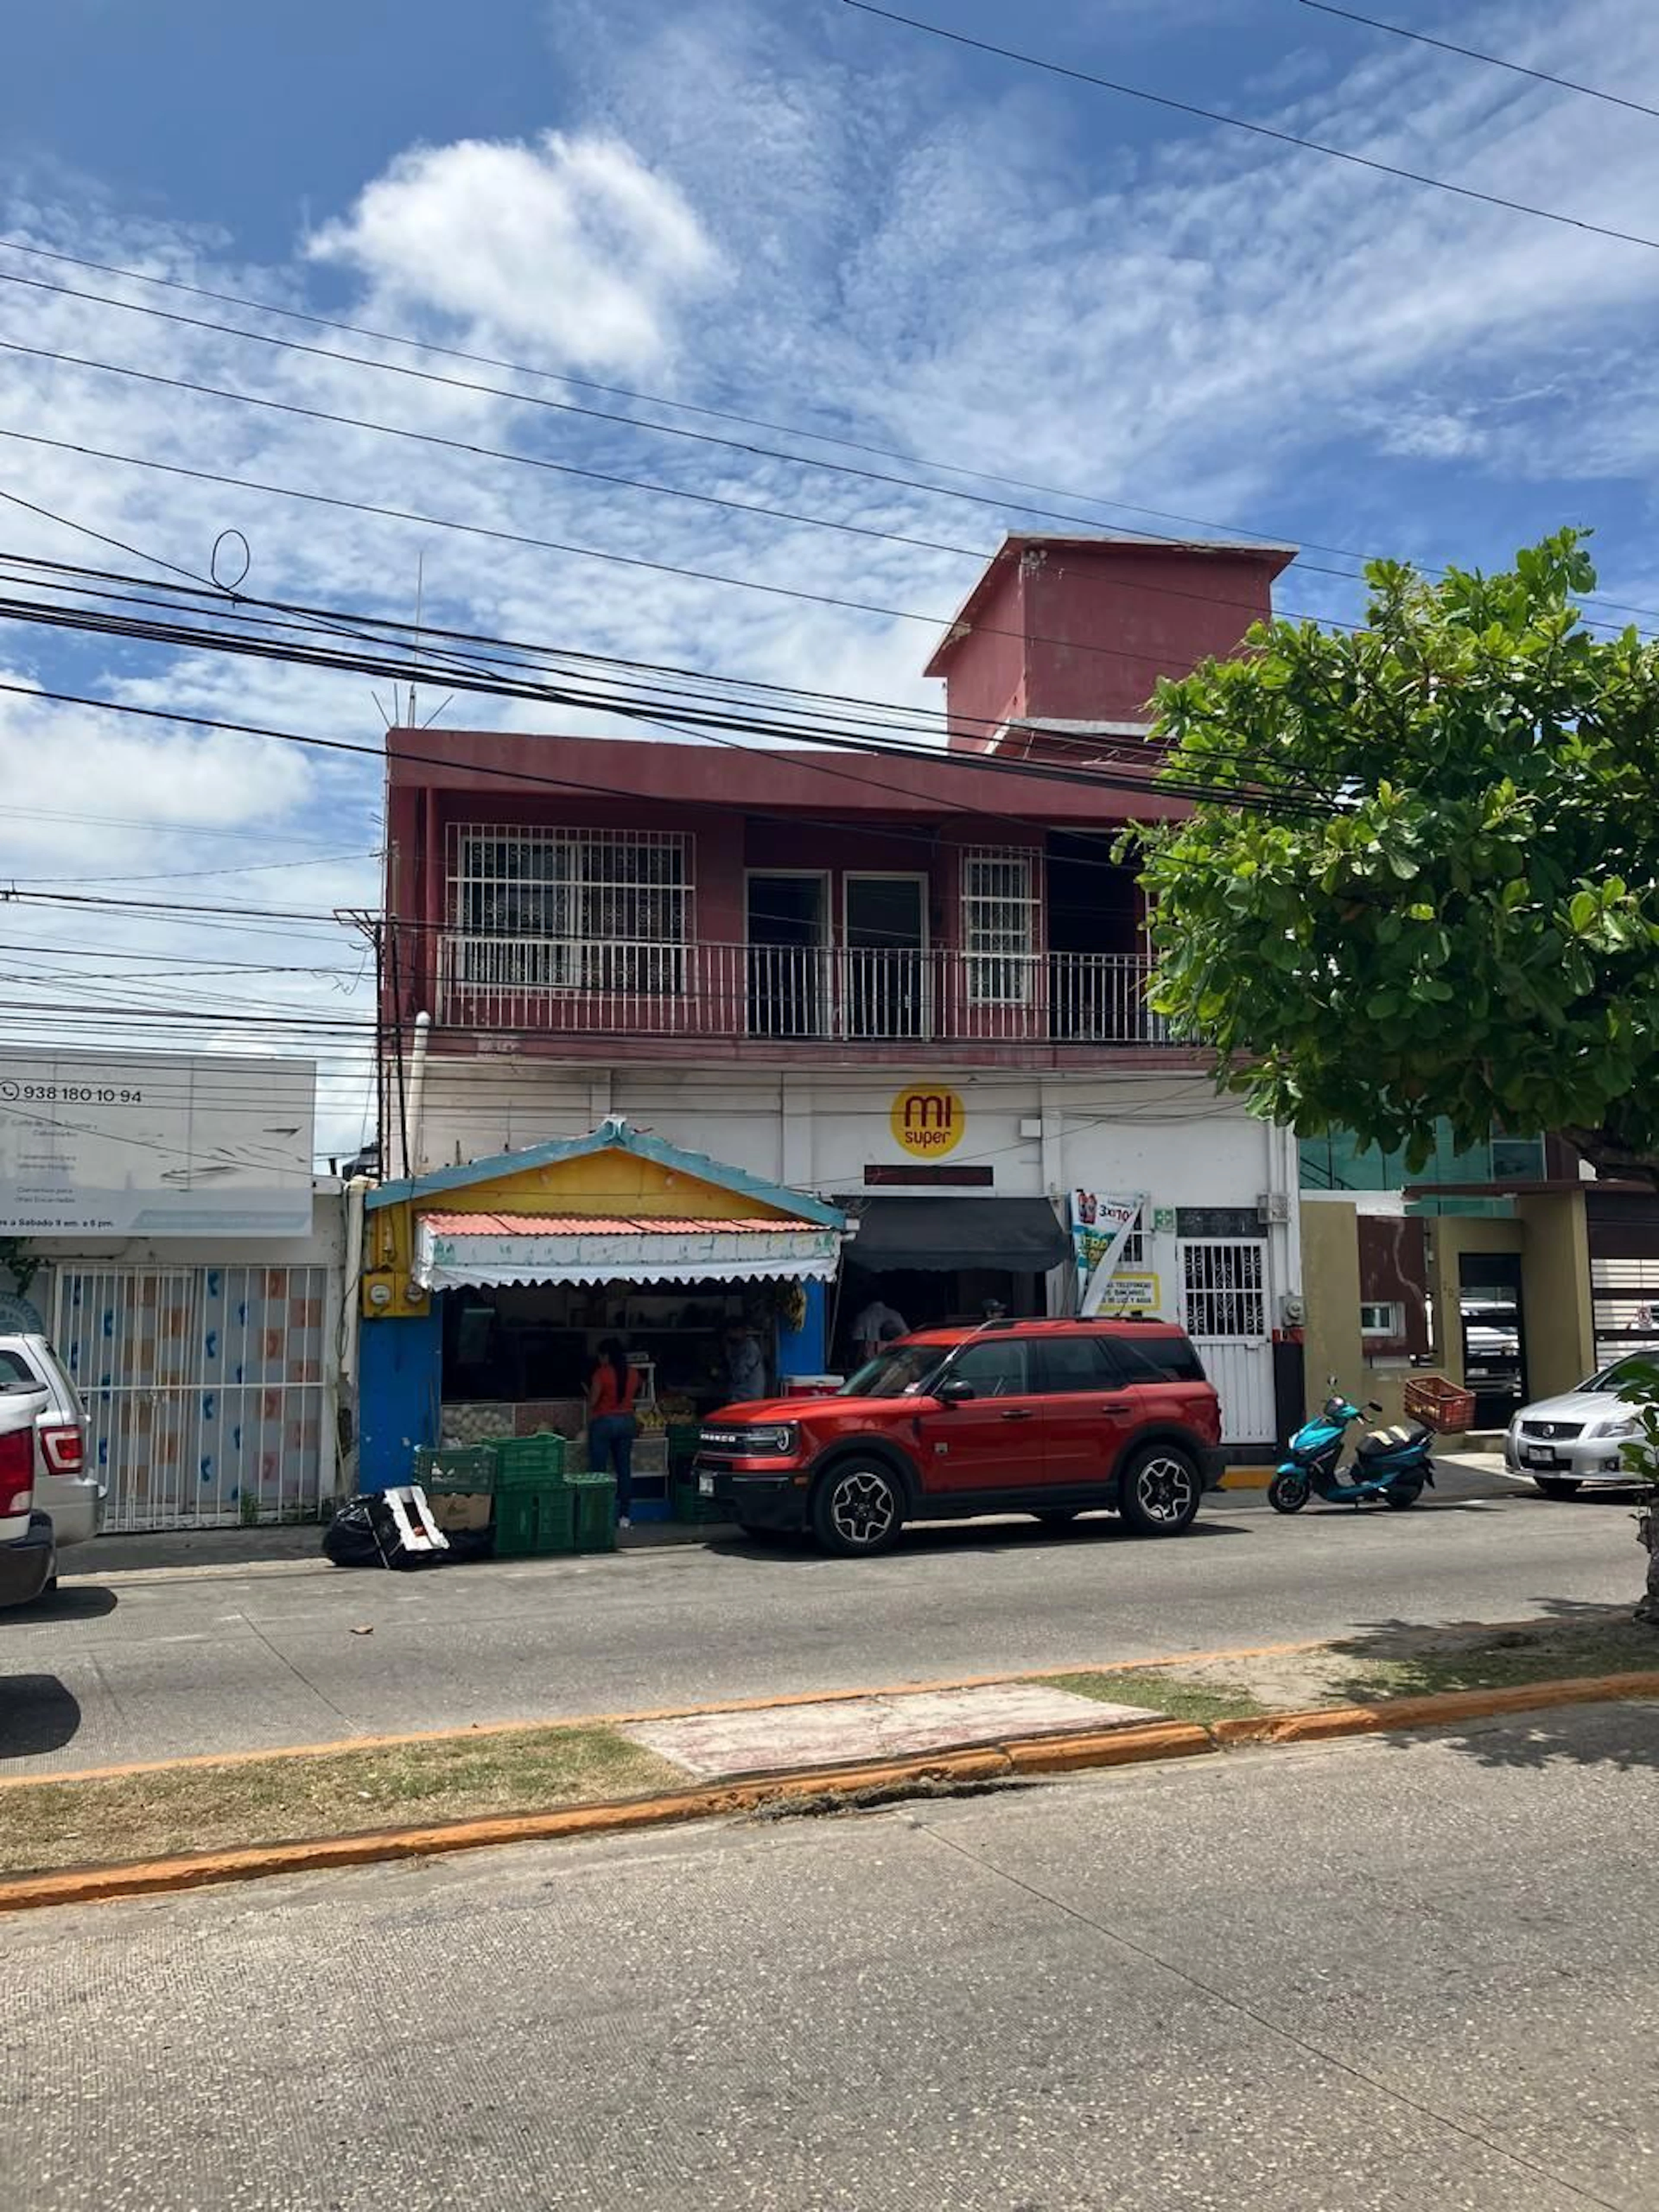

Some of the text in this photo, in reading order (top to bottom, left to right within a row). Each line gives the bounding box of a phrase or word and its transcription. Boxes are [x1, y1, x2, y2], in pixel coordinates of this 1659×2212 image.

[25, 1086, 141, 1103] 938 180 10 94
[906, 1131, 950, 1148] super
